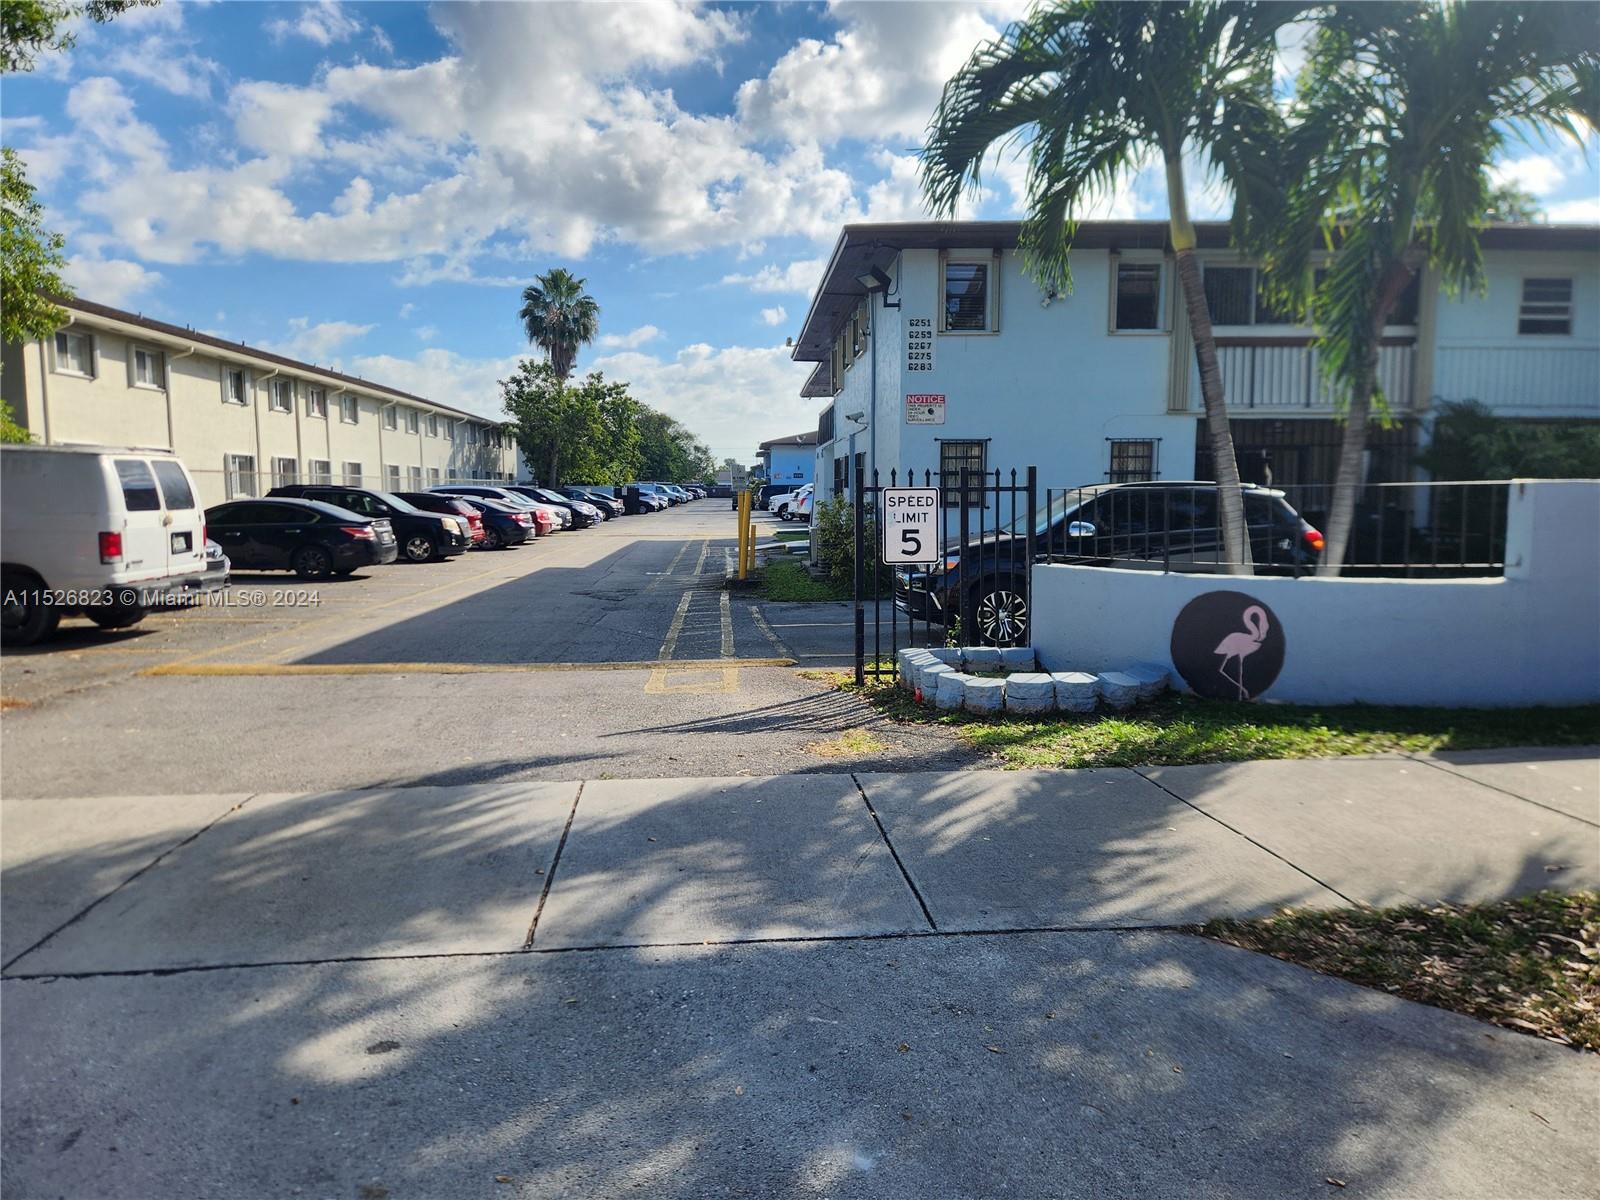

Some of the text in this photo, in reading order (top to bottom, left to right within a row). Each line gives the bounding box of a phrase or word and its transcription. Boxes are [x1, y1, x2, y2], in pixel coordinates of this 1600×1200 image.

[909, 319, 931, 327] 6251
[909, 331, 932, 339] 6259
[908, 342, 932, 350] 6267
[908, 352, 932, 360] 6275
[908, 362, 932, 371] 6283
[907, 395, 945, 403] NOTICE
[888, 496, 934, 507] SPEED
[901, 529, 922, 556] 5
